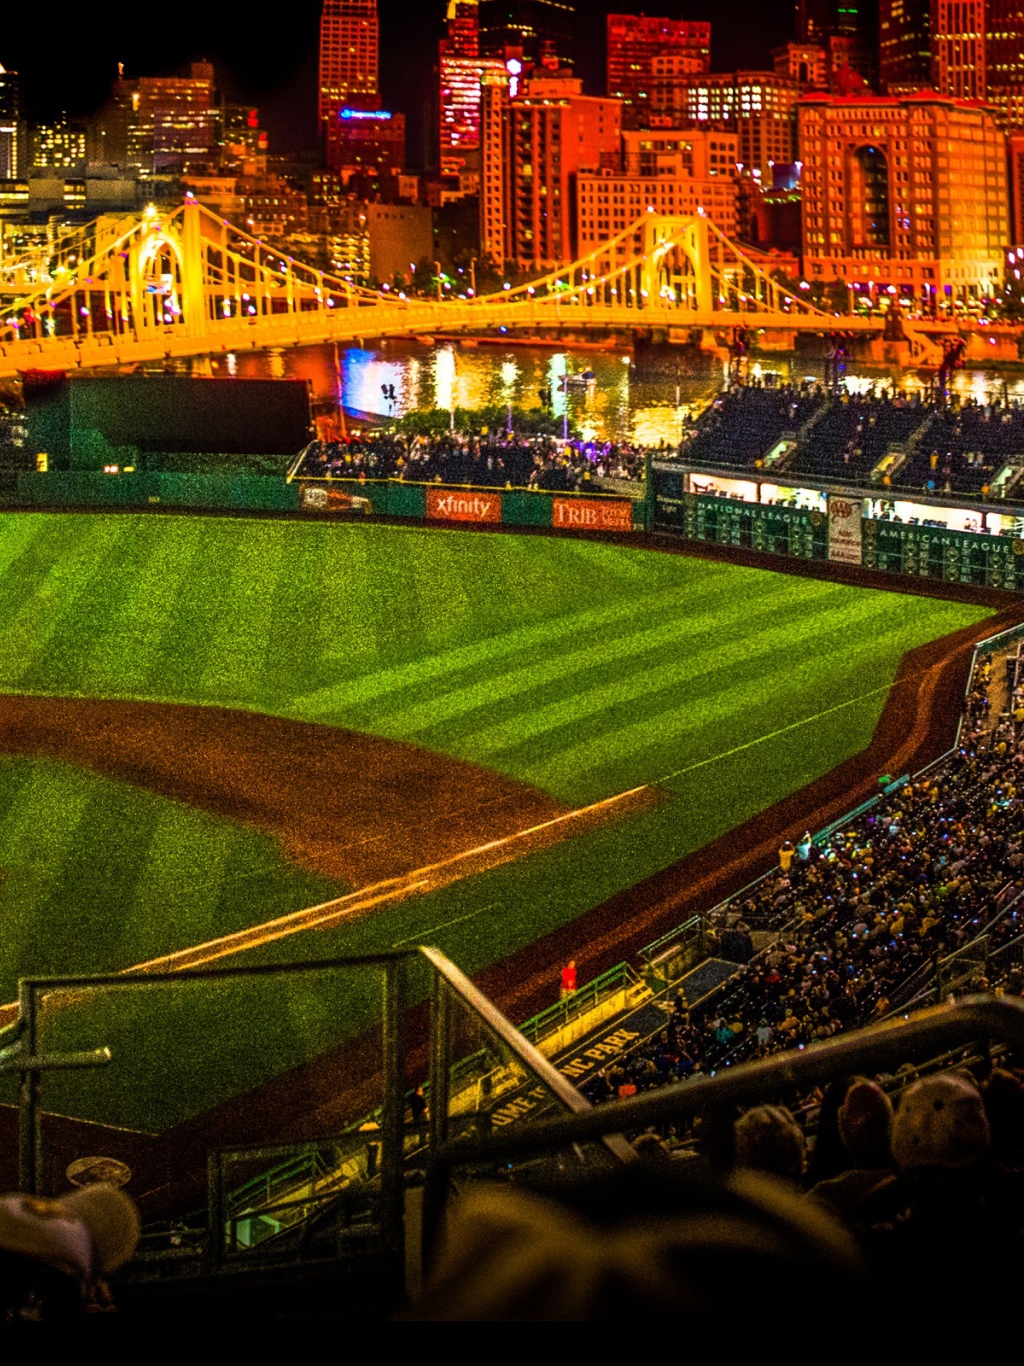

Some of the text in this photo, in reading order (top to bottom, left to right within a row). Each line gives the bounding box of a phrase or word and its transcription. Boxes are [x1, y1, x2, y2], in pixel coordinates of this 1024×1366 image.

[437, 496, 491, 518] xfinity
[554, 503, 596, 524] TRIB
[697, 502, 807, 525] NATIONAL LEAGUE
[880, 529, 1009, 554] AMERICAN LEAGUE
[584, 1028, 640, 1060] PARK
